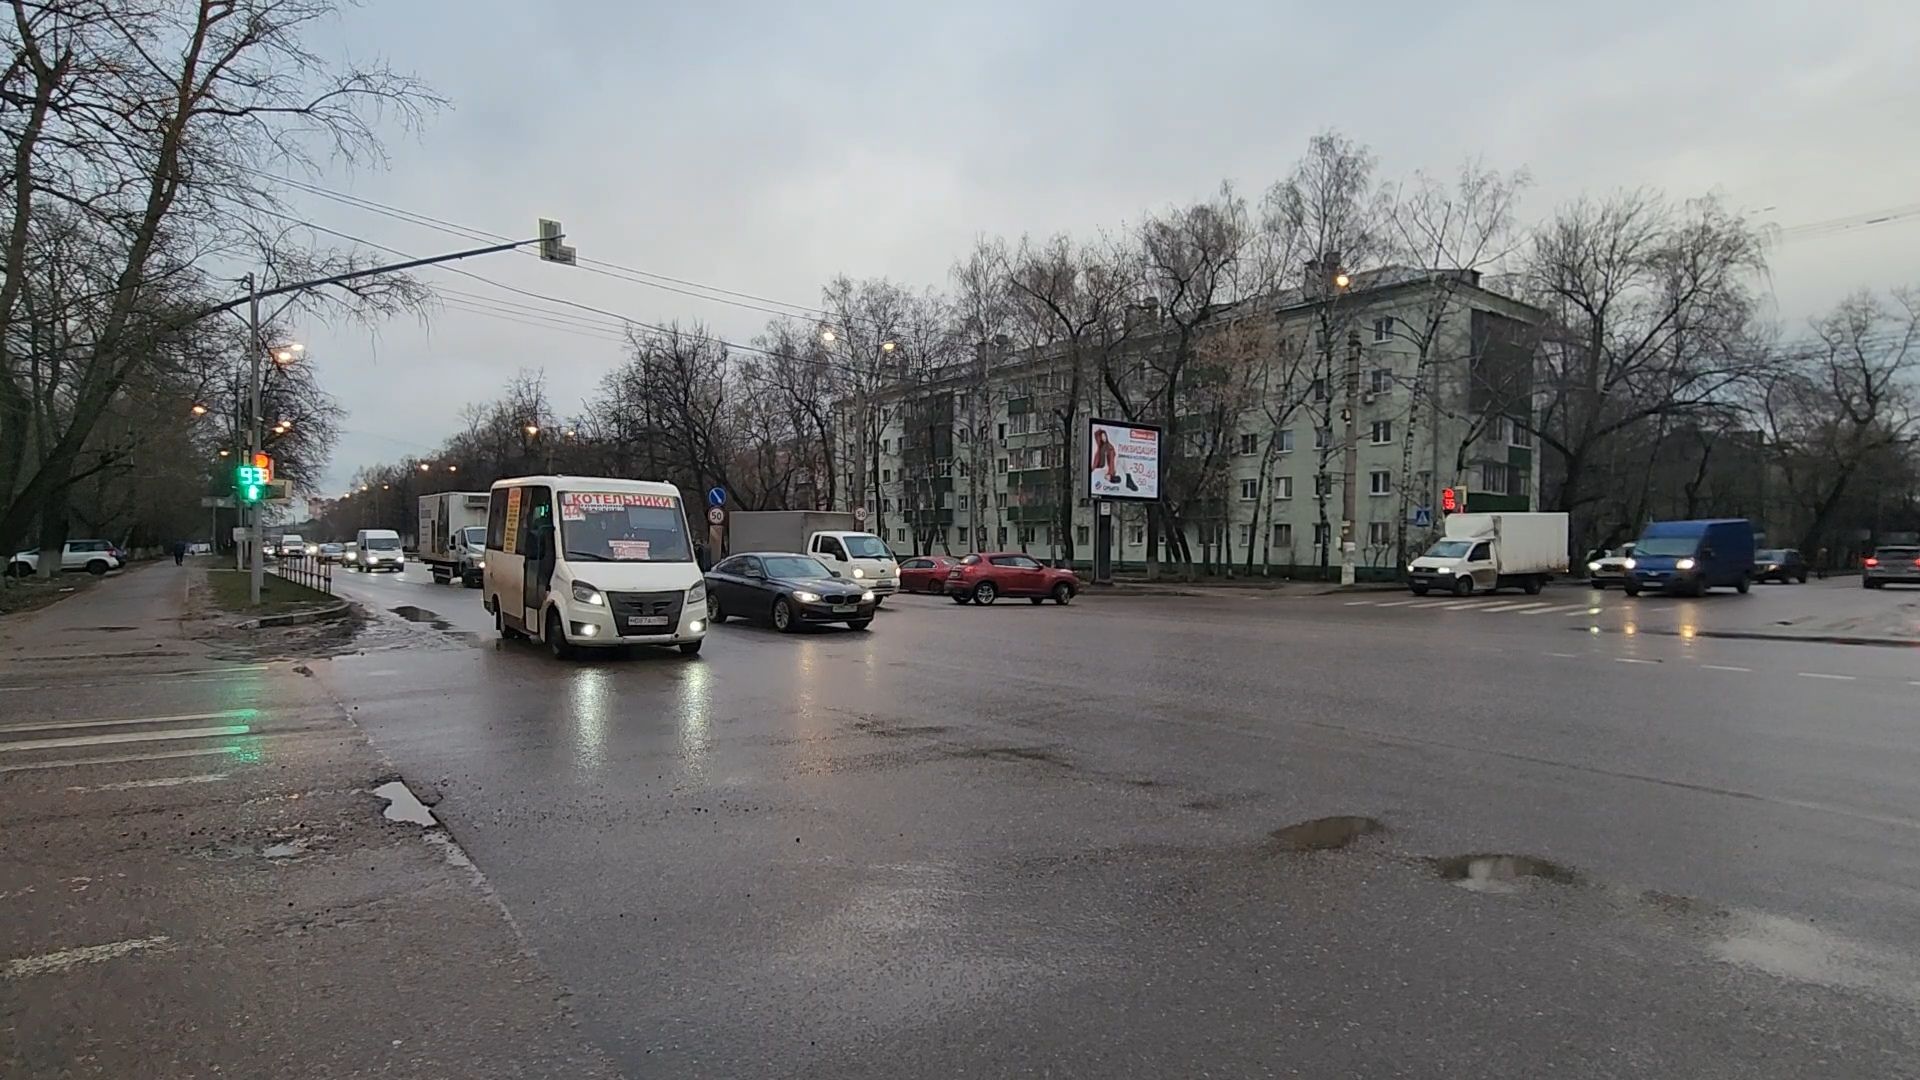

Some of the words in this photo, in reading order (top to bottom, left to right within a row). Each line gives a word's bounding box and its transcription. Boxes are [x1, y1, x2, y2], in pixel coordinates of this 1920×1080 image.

[1129, 462, 1144, 474] -30
[240, 467, 263, 484] 93
[572, 494, 671, 507] КОТЕЛЬНИКИ
[711, 512, 722, 520] 50
